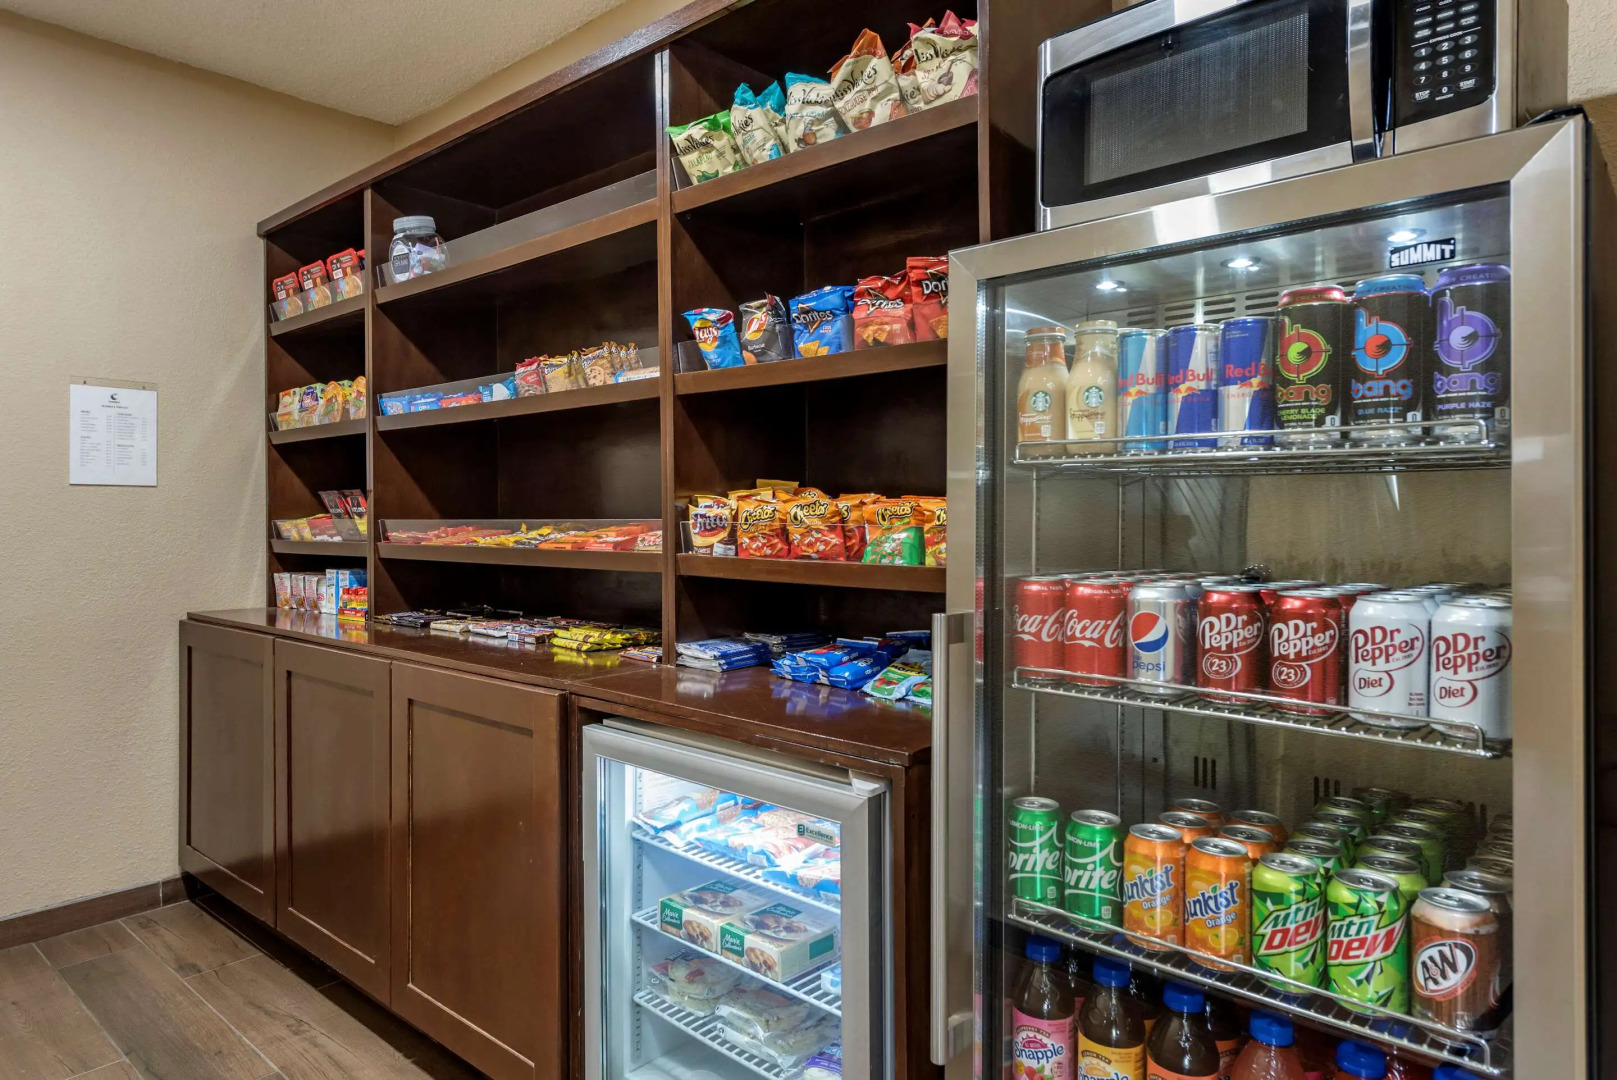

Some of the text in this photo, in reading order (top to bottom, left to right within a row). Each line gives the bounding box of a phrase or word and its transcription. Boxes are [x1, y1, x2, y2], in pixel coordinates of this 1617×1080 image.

[1442, 42, 1448, 50] 2
[1464, 36, 1471, 44] 3
[1420, 48, 1426, 56] 1
[1442, 56, 1448, 64] 5
[1464, 50, 1471, 58] 6
[1419, 62, 1426, 70] 4
[1442, 70, 1448, 78] 8
[1464, 64, 1471, 72] 9
[1420, 76, 1426, 84] 7
[1460, 78, 1476, 87] START
[1415, 90, 1430, 98] STOP
[1391, 243, 1455, 267] SUMMIT
[793, 310, 834, 324] Doritos
[1225, 361, 1256, 378] Red
[1350, 378, 1414, 401] bang
[1433, 371, 1502, 396] bang
[1275, 383, 1332, 406] bang
[1357, 407, 1376, 416] BLUE
[1437, 402, 1466, 410] PURPLE
[740, 504, 778, 532] Cheetos
[788, 499, 829, 528] Cheetos
[875, 505, 915, 527] Cheetos
[1220, 612, 1248, 634] Dr
[1288, 619, 1318, 641] Dr
[1200, 616, 1262, 651] Pepper
[1270, 622, 1335, 660] Pepper
[1369, 625, 1401, 646] Dr
[1351, 628, 1420, 667] Pepper
[1451, 632, 1486, 654] Dr
[1432, 634, 1508, 676] Pepper
[1132, 660, 1166, 677] pepsi
[1211, 658, 1228, 672] 23
[1280, 666, 1296, 681] 23
[1358, 673, 1384, 690] Diet
[1439, 685, 1466, 700] Diet
[805, 827, 834, 841] Excellence
[1142, 894, 1172, 910] Orange
[664, 907, 680, 919] Marie
[1205, 911, 1238, 928] Orange
[724, 933, 741, 945] Marie
[1420, 943, 1459, 992] A&W
[1014, 1040, 1065, 1065] Snapple
